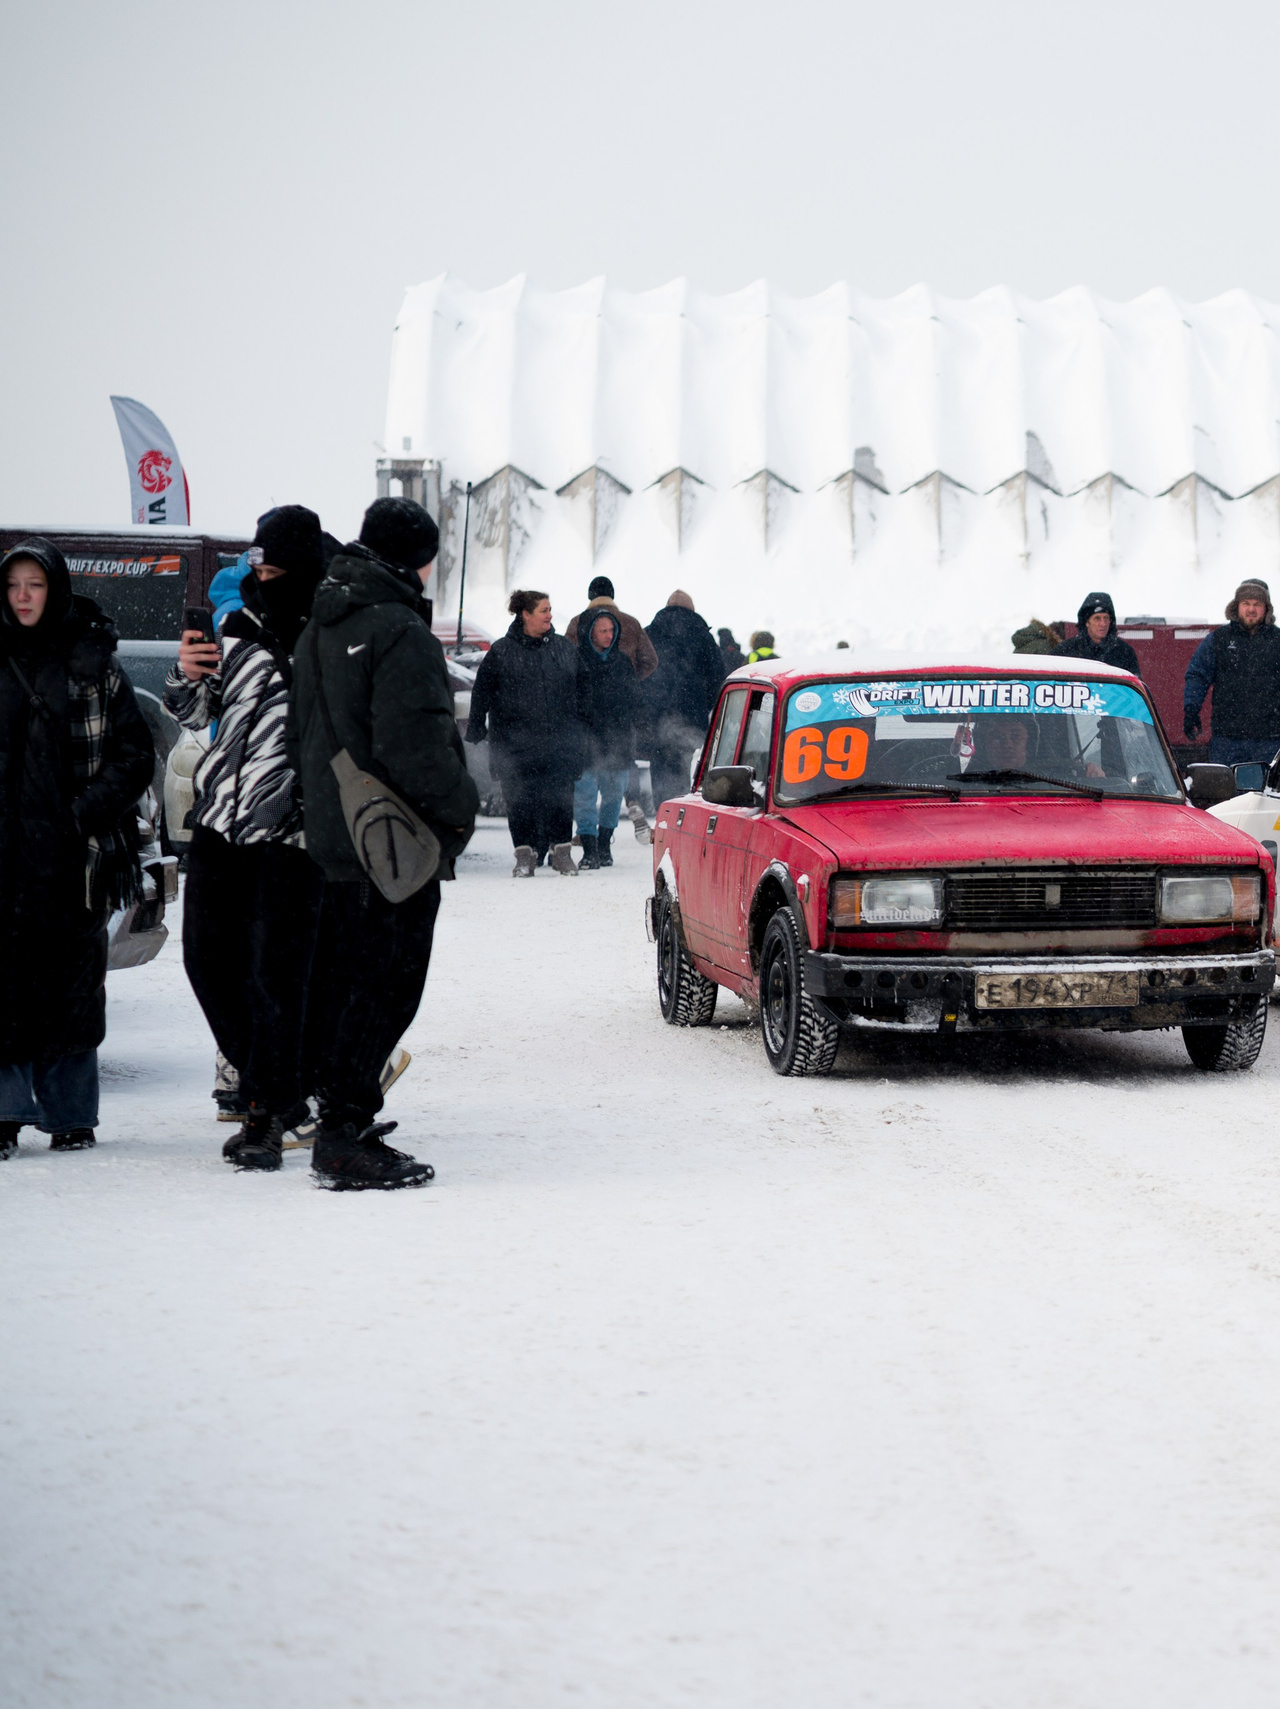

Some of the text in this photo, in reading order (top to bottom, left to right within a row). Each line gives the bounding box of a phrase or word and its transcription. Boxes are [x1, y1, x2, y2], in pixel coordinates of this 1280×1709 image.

[95, 560, 125, 574] EXPO
[126, 562, 147, 576] CUP
[869, 690, 920, 701] DRIFT
[922, 684, 1091, 708] WINTER CUP
[782, 726, 869, 784] 69
